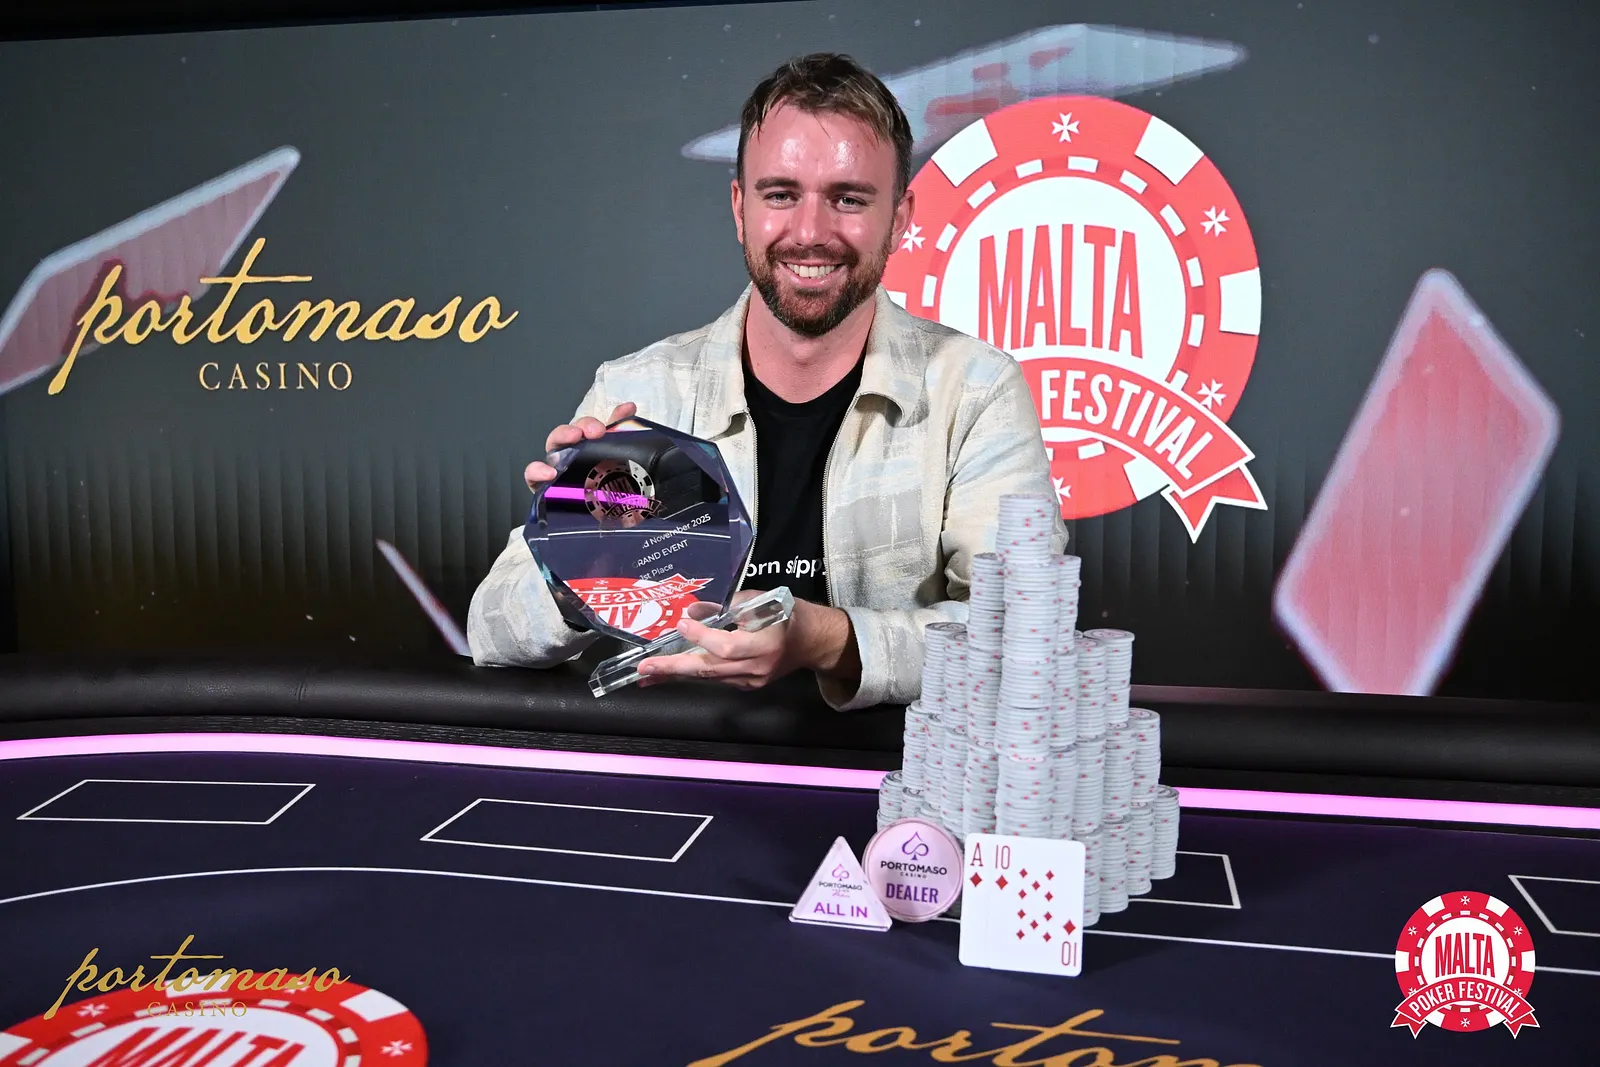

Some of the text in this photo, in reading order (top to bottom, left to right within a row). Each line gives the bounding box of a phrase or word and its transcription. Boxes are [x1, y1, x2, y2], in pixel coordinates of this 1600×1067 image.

[978, 223, 1143, 360] MALTA
[47, 237, 519, 395] portomaso
[199, 362, 353, 390] CASINO
[1041, 369, 1213, 480] FESTIVAL
[649, 522, 690, 546] November
[691, 513, 712, 528] 2025
[661, 539, 689, 557] EVENT
[651, 563, 674, 577] Place
[745, 560, 781, 577] orn
[970, 842, 984, 867] A
[995, 844, 1011, 870] 10
[880, 860, 948, 876] PORTOMASO
[900, 871, 927, 879] CASINO
[819, 881, 863, 891] PORTOMASO
[886, 882, 939, 904] DEALER
[813, 902, 868, 918] ALL IN
